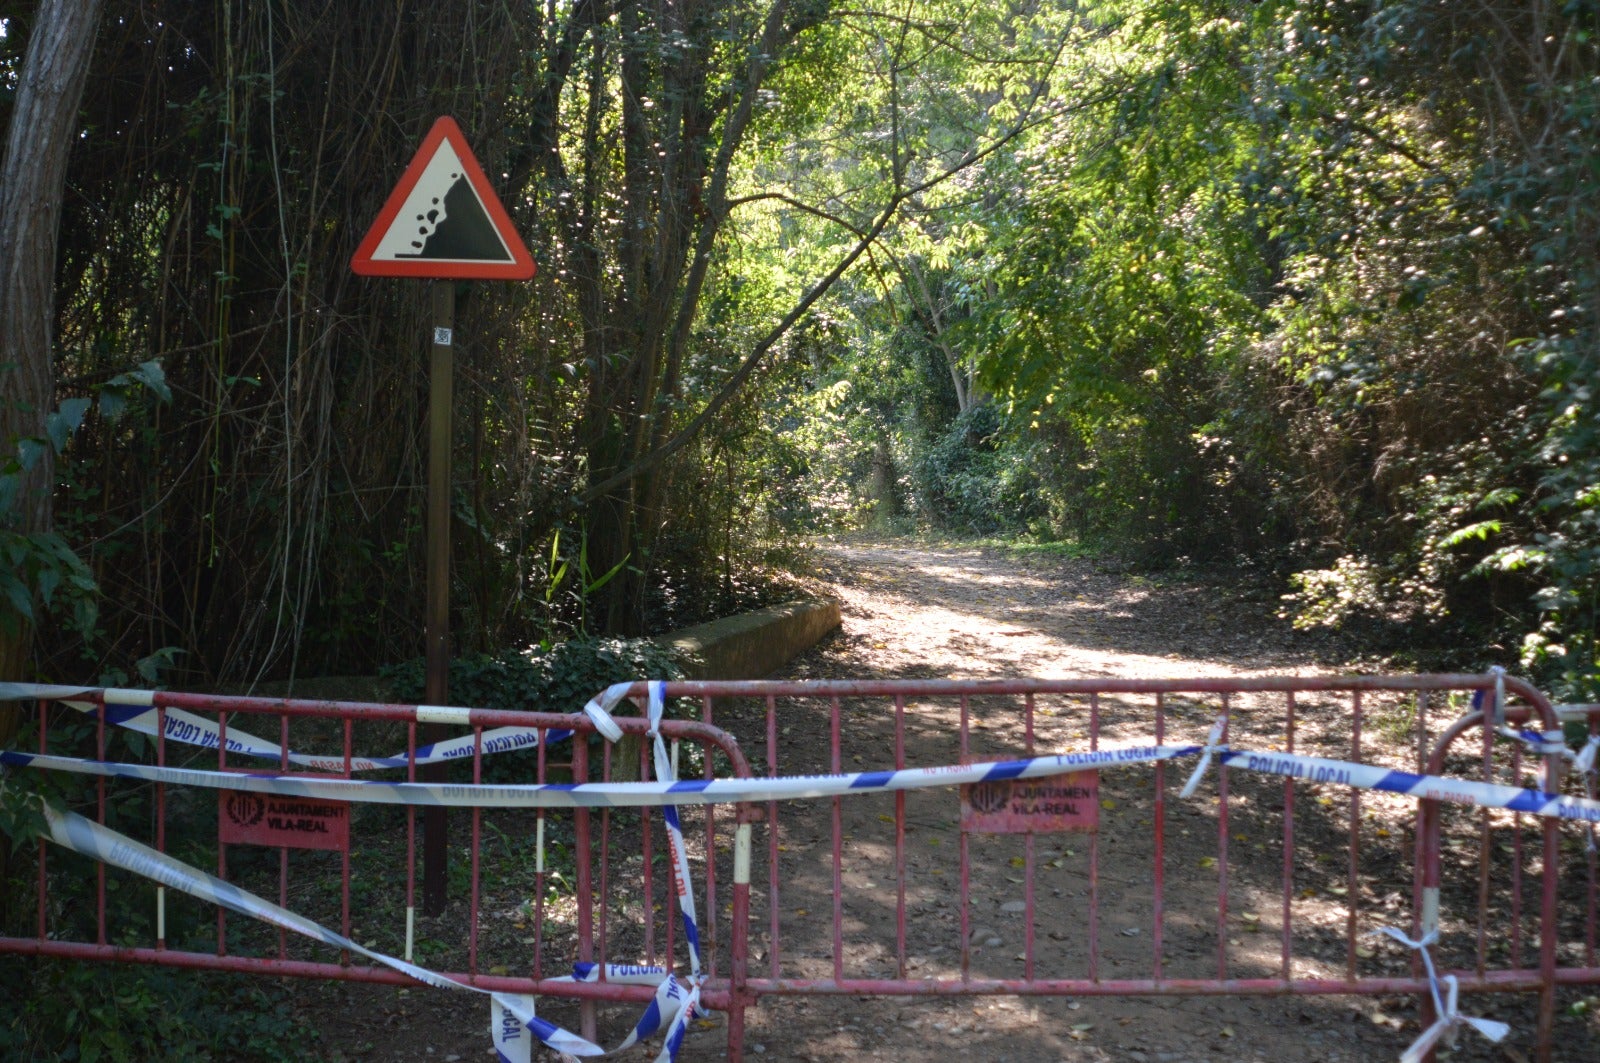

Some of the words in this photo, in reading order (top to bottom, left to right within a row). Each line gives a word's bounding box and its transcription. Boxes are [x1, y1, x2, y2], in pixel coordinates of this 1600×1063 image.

[1249, 755, 1304, 778] POLICIA
[1308, 764, 1351, 785] LOCAL
[1012, 786, 1096, 799] AJUNTAMEN
[267, 802, 344, 818] AJUNTAMENT
[267, 818, 329, 833] VILA-REAL
